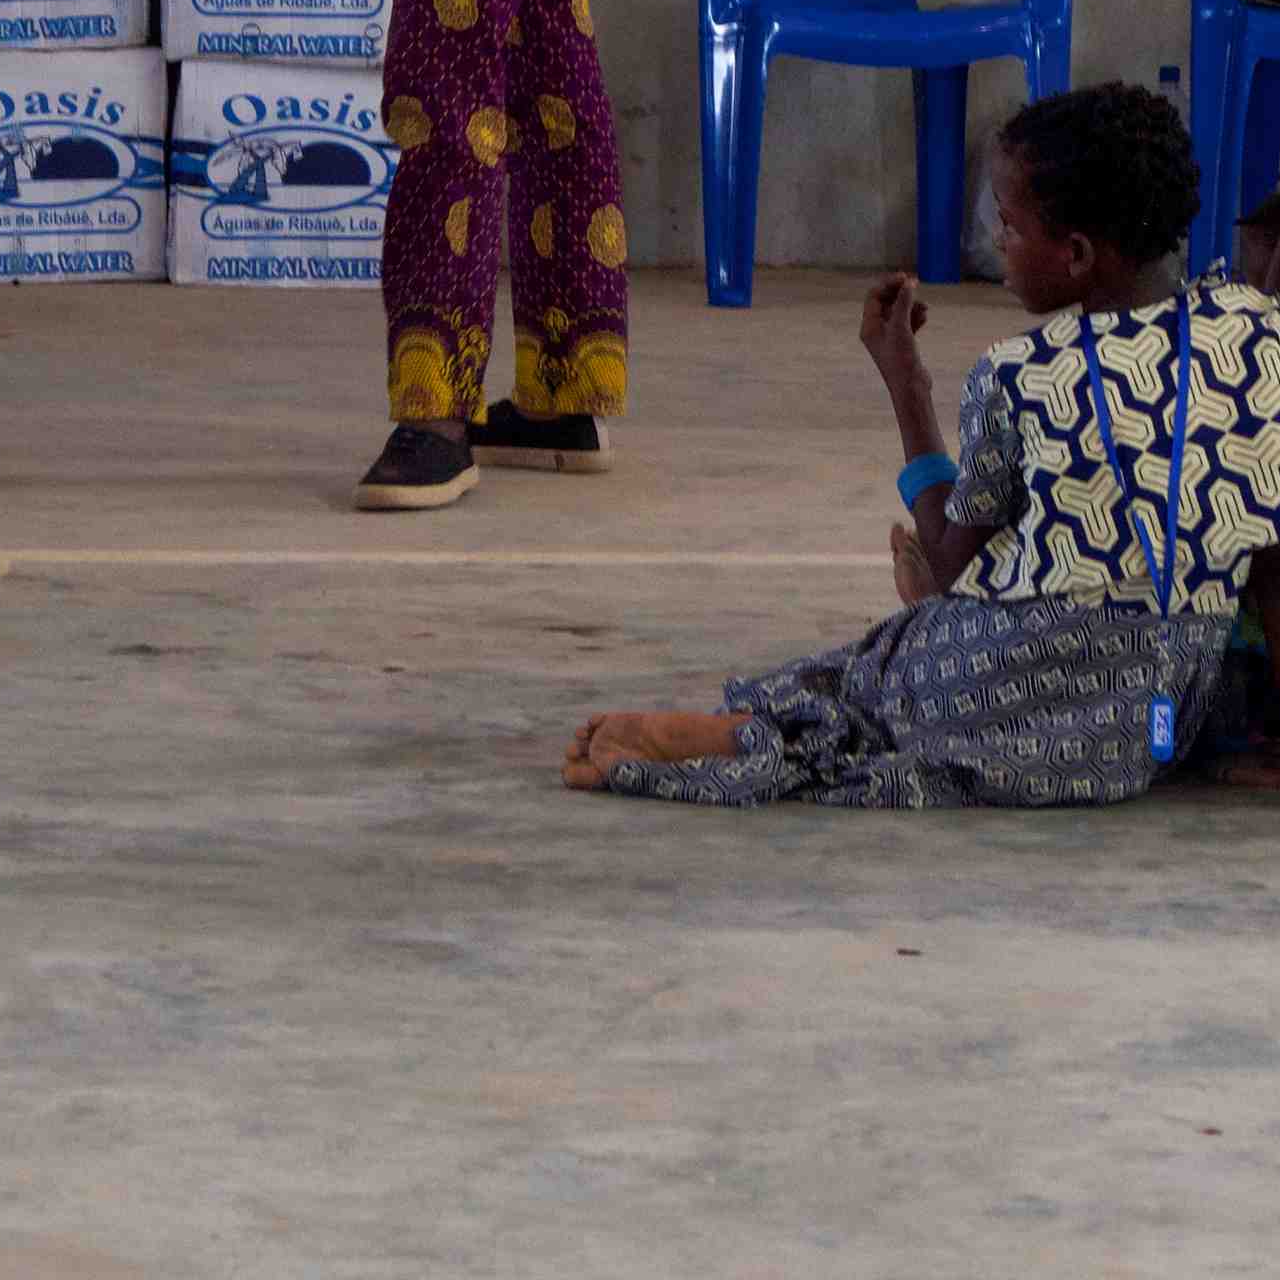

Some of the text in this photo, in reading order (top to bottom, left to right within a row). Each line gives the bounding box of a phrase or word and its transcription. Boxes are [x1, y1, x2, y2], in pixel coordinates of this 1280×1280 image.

[222, 92, 377, 131] Oasis
[15, 210, 34, 226] de
[264, 216, 283, 231] de
